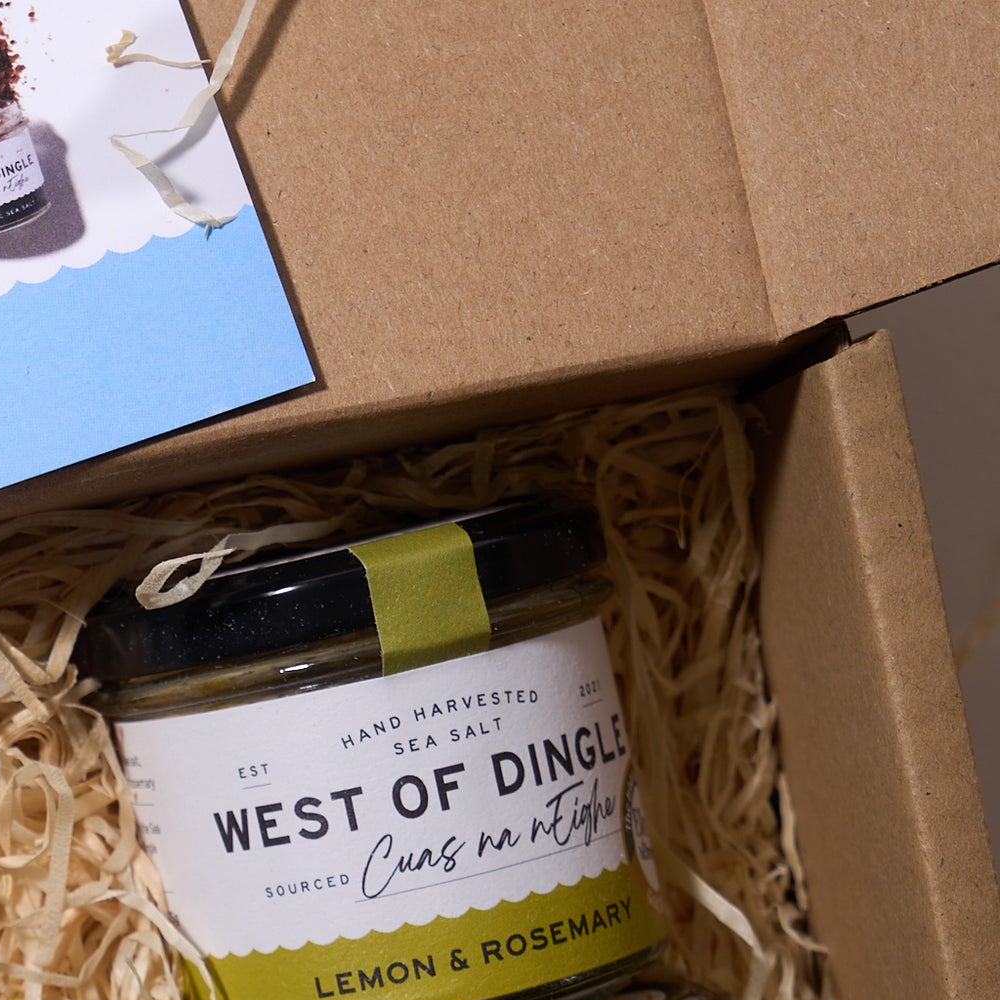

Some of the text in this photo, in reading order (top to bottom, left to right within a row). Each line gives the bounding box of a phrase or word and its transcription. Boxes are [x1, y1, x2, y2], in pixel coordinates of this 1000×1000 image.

[5, 207, 20, 216] SEA
[579, 680, 601, 697] 2021
[340, 690, 540, 749] HAND HARVESTED
[392, 717, 503, 756] SEA SALT
[213, 713, 628, 854] WEST OF DINGLE
[238, 763, 270, 779] EST
[360, 833, 467, 900] Cuas
[476, 828, 521, 858] na
[264, 873, 351, 899] SOURCED
[314, 898, 633, 1000] LEMON & ROSEMARY
